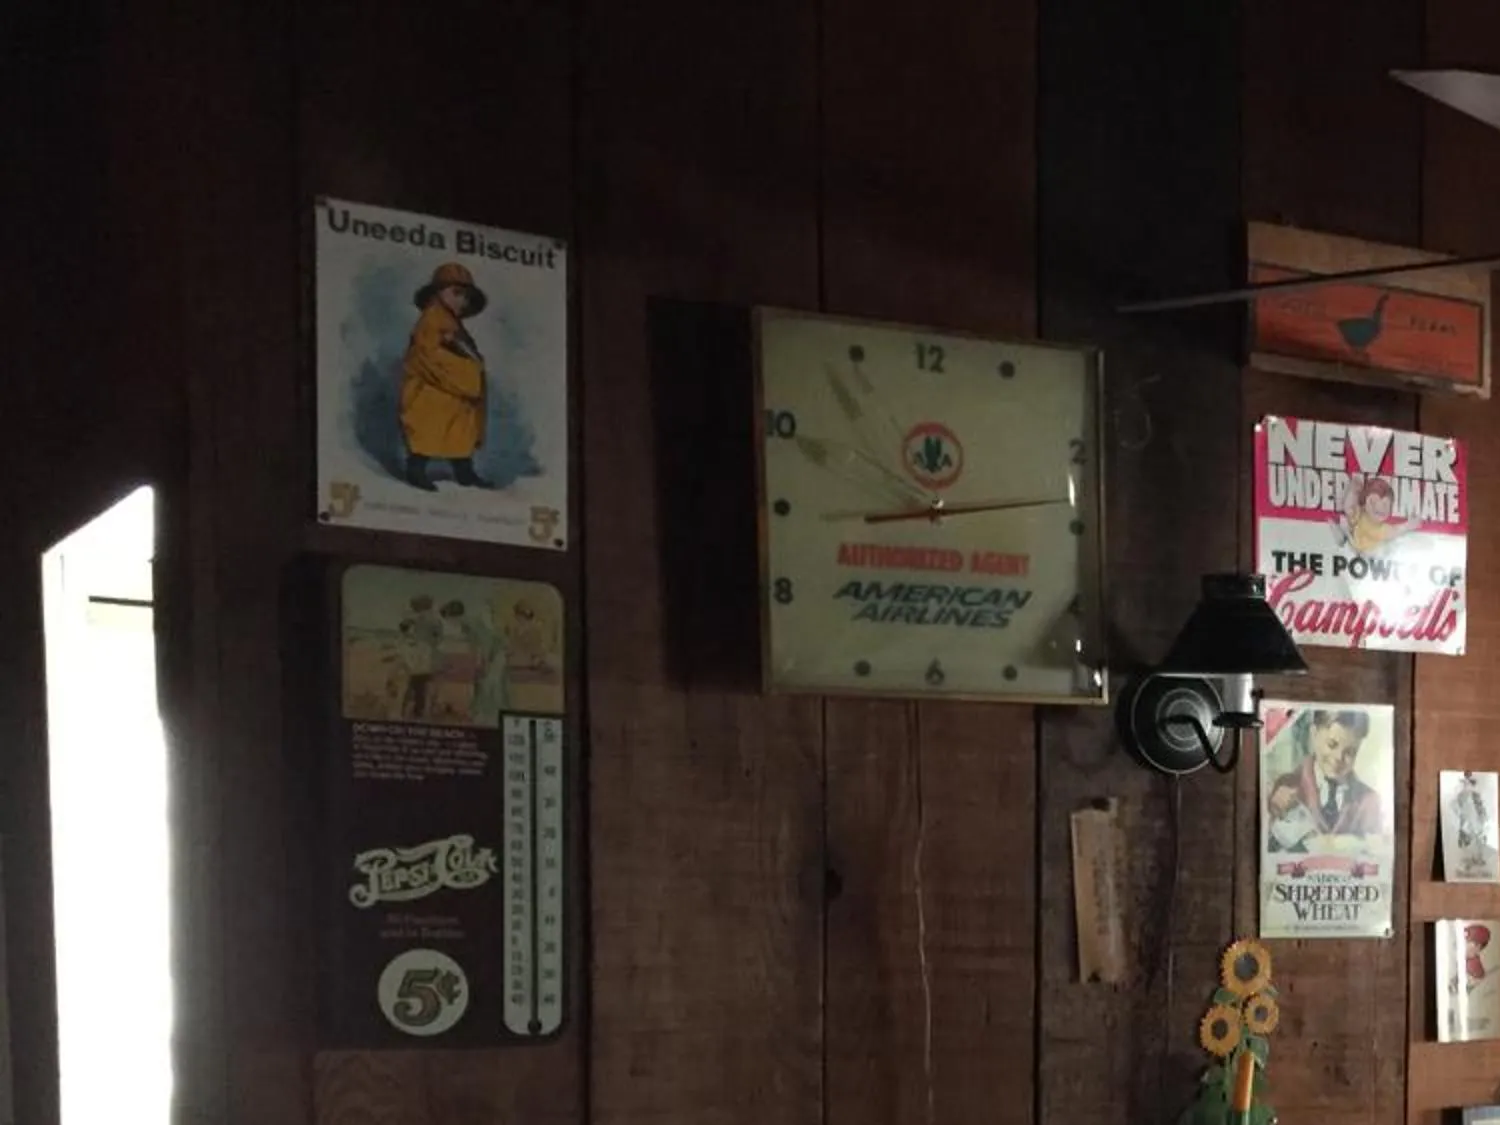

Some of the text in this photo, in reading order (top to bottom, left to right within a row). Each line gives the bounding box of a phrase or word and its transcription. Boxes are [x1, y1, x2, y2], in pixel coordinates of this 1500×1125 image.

[327, 206, 558, 270] Uneeda Biscuit
[914, 343, 945, 373] 12
[1068, 439, 1088, 466] 2
[1267, 416, 1459, 484] NEVER
[1268, 464, 1460, 523] UNDERIMATE
[1271, 550, 1324, 577] THE
[1332, 554, 1419, 582] POW
[773, 577, 794, 605] 8
[832, 580, 1033, 609] AMERICAN
[851, 602, 1014, 629] AIRLINES
[925, 657, 945, 687] 6
[1275, 883, 1380, 904] SHREDDED
[1292, 901, 1361, 922] WHEAT
